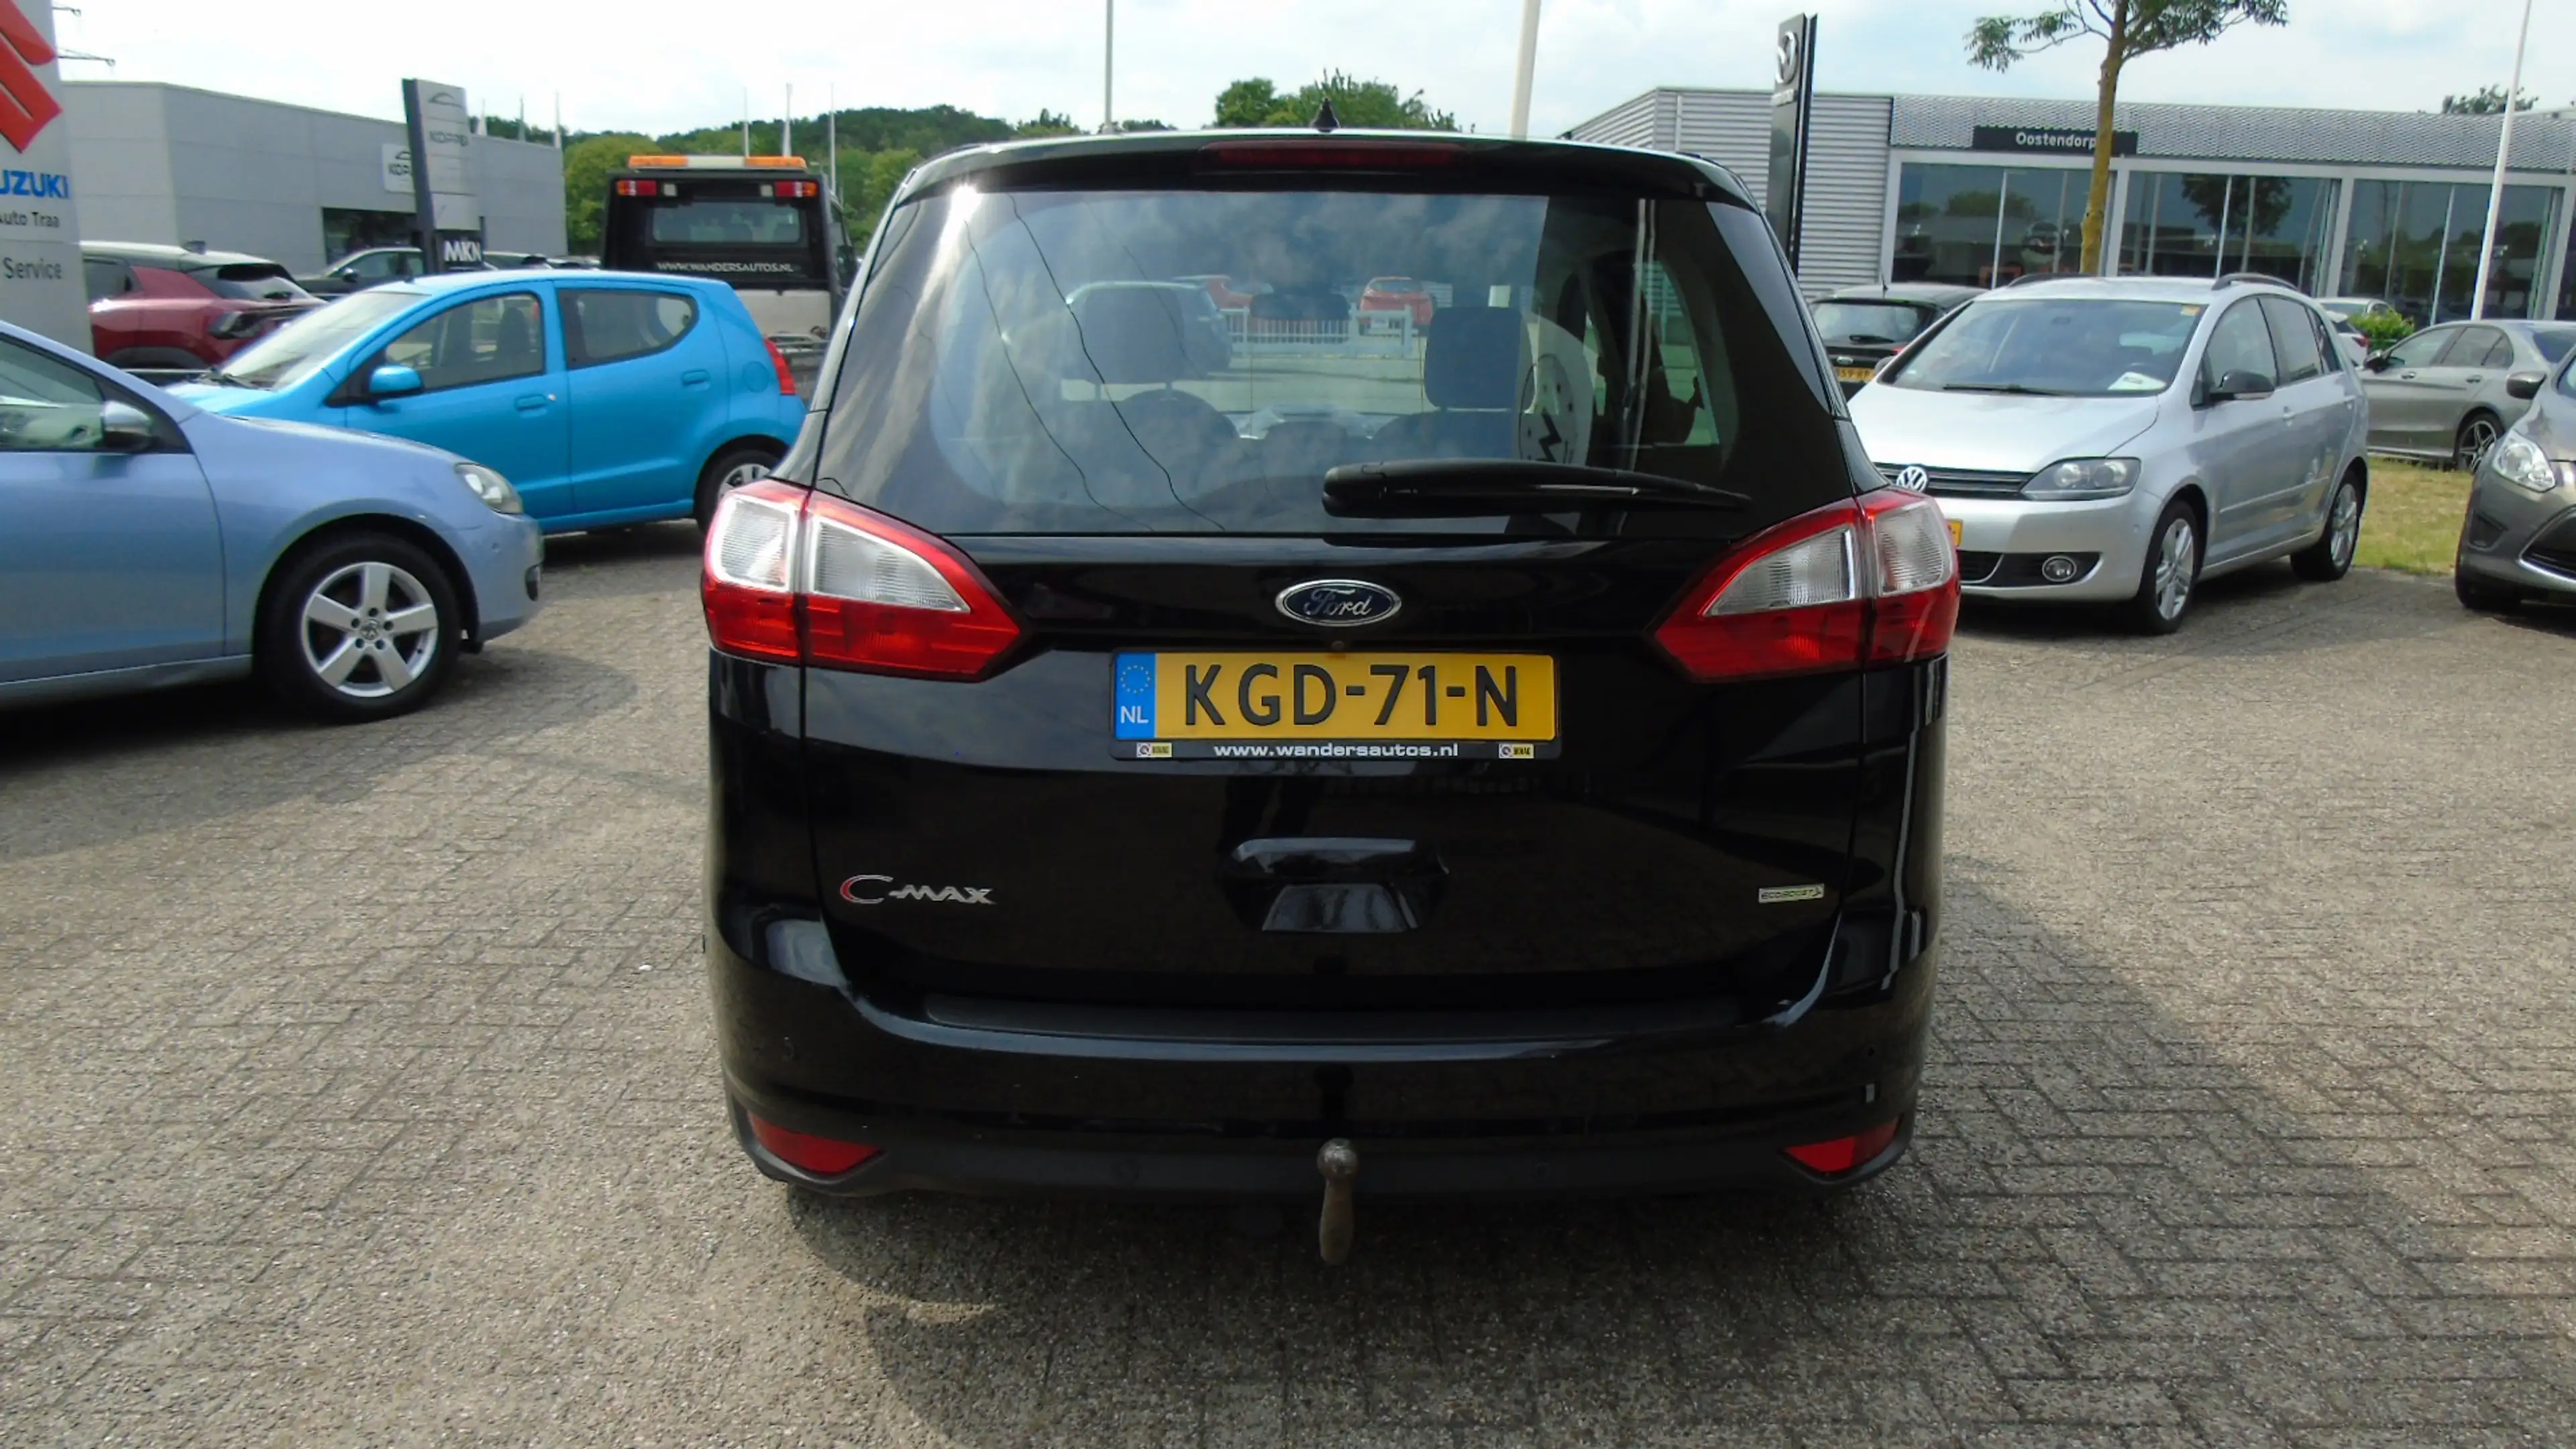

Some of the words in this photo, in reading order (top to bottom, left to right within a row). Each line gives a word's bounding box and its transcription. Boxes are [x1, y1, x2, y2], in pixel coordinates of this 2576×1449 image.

[2016, 131, 2097, 150] Oostendorp
[444, 240, 482, 261] MKN
[3, 256, 62, 279] Service
[1303, 586, 1373, 616] Ford
[1184, 663, 1517, 727] KGD-71-N
[1120, 706, 1149, 724] NL
[1214, 743, 1459, 757] www.wandersautos.nl
